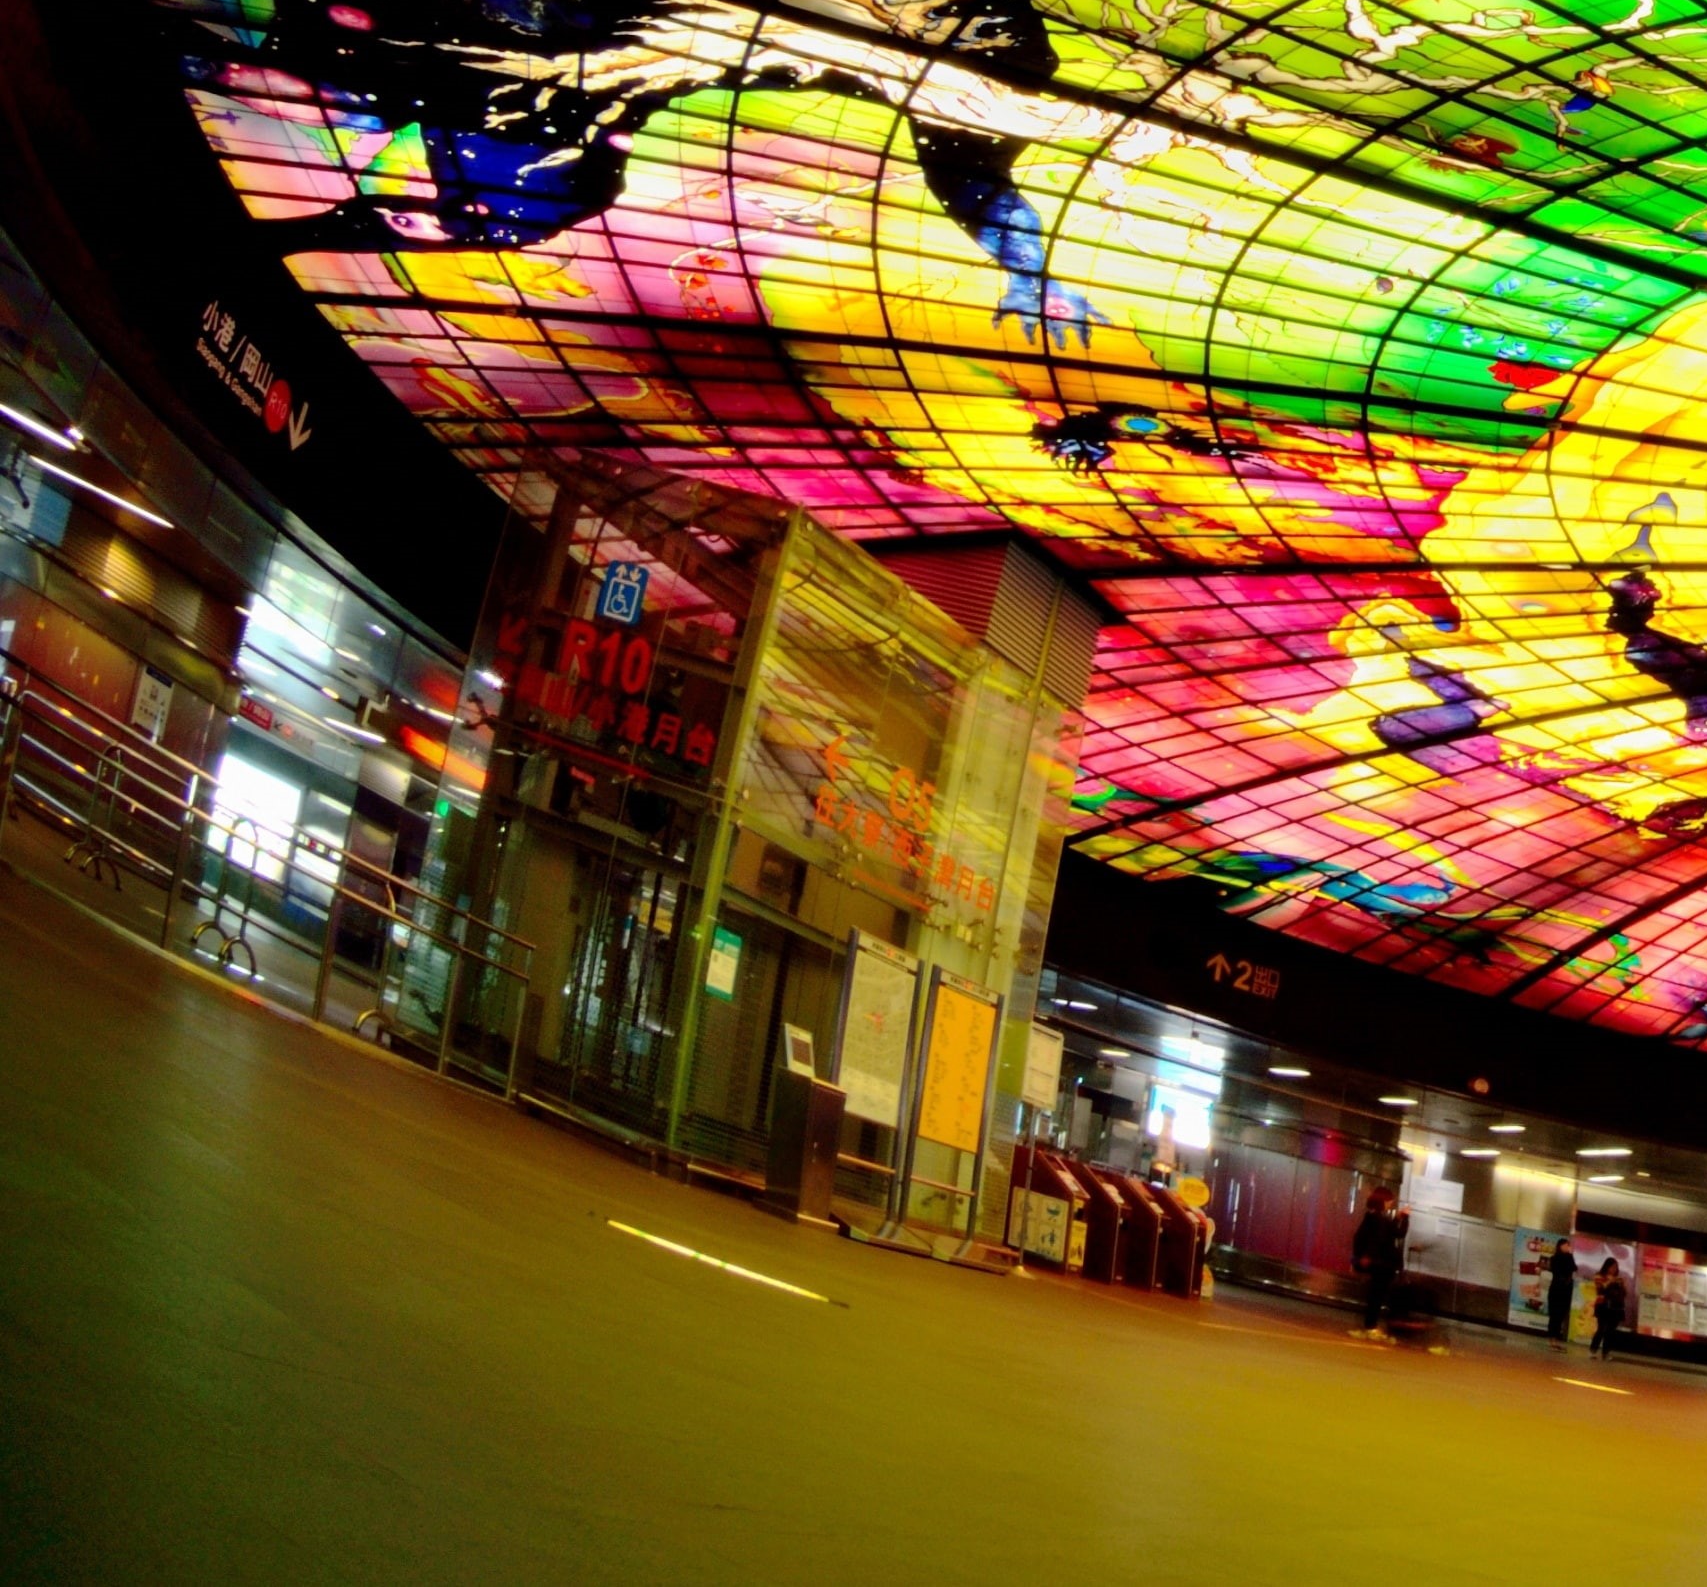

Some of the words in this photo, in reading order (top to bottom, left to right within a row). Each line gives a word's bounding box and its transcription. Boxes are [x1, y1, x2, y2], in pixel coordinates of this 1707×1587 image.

[268, 391, 288, 420] R10
[560, 618, 654, 695] R10
[1233, 960, 1252, 991] 2
